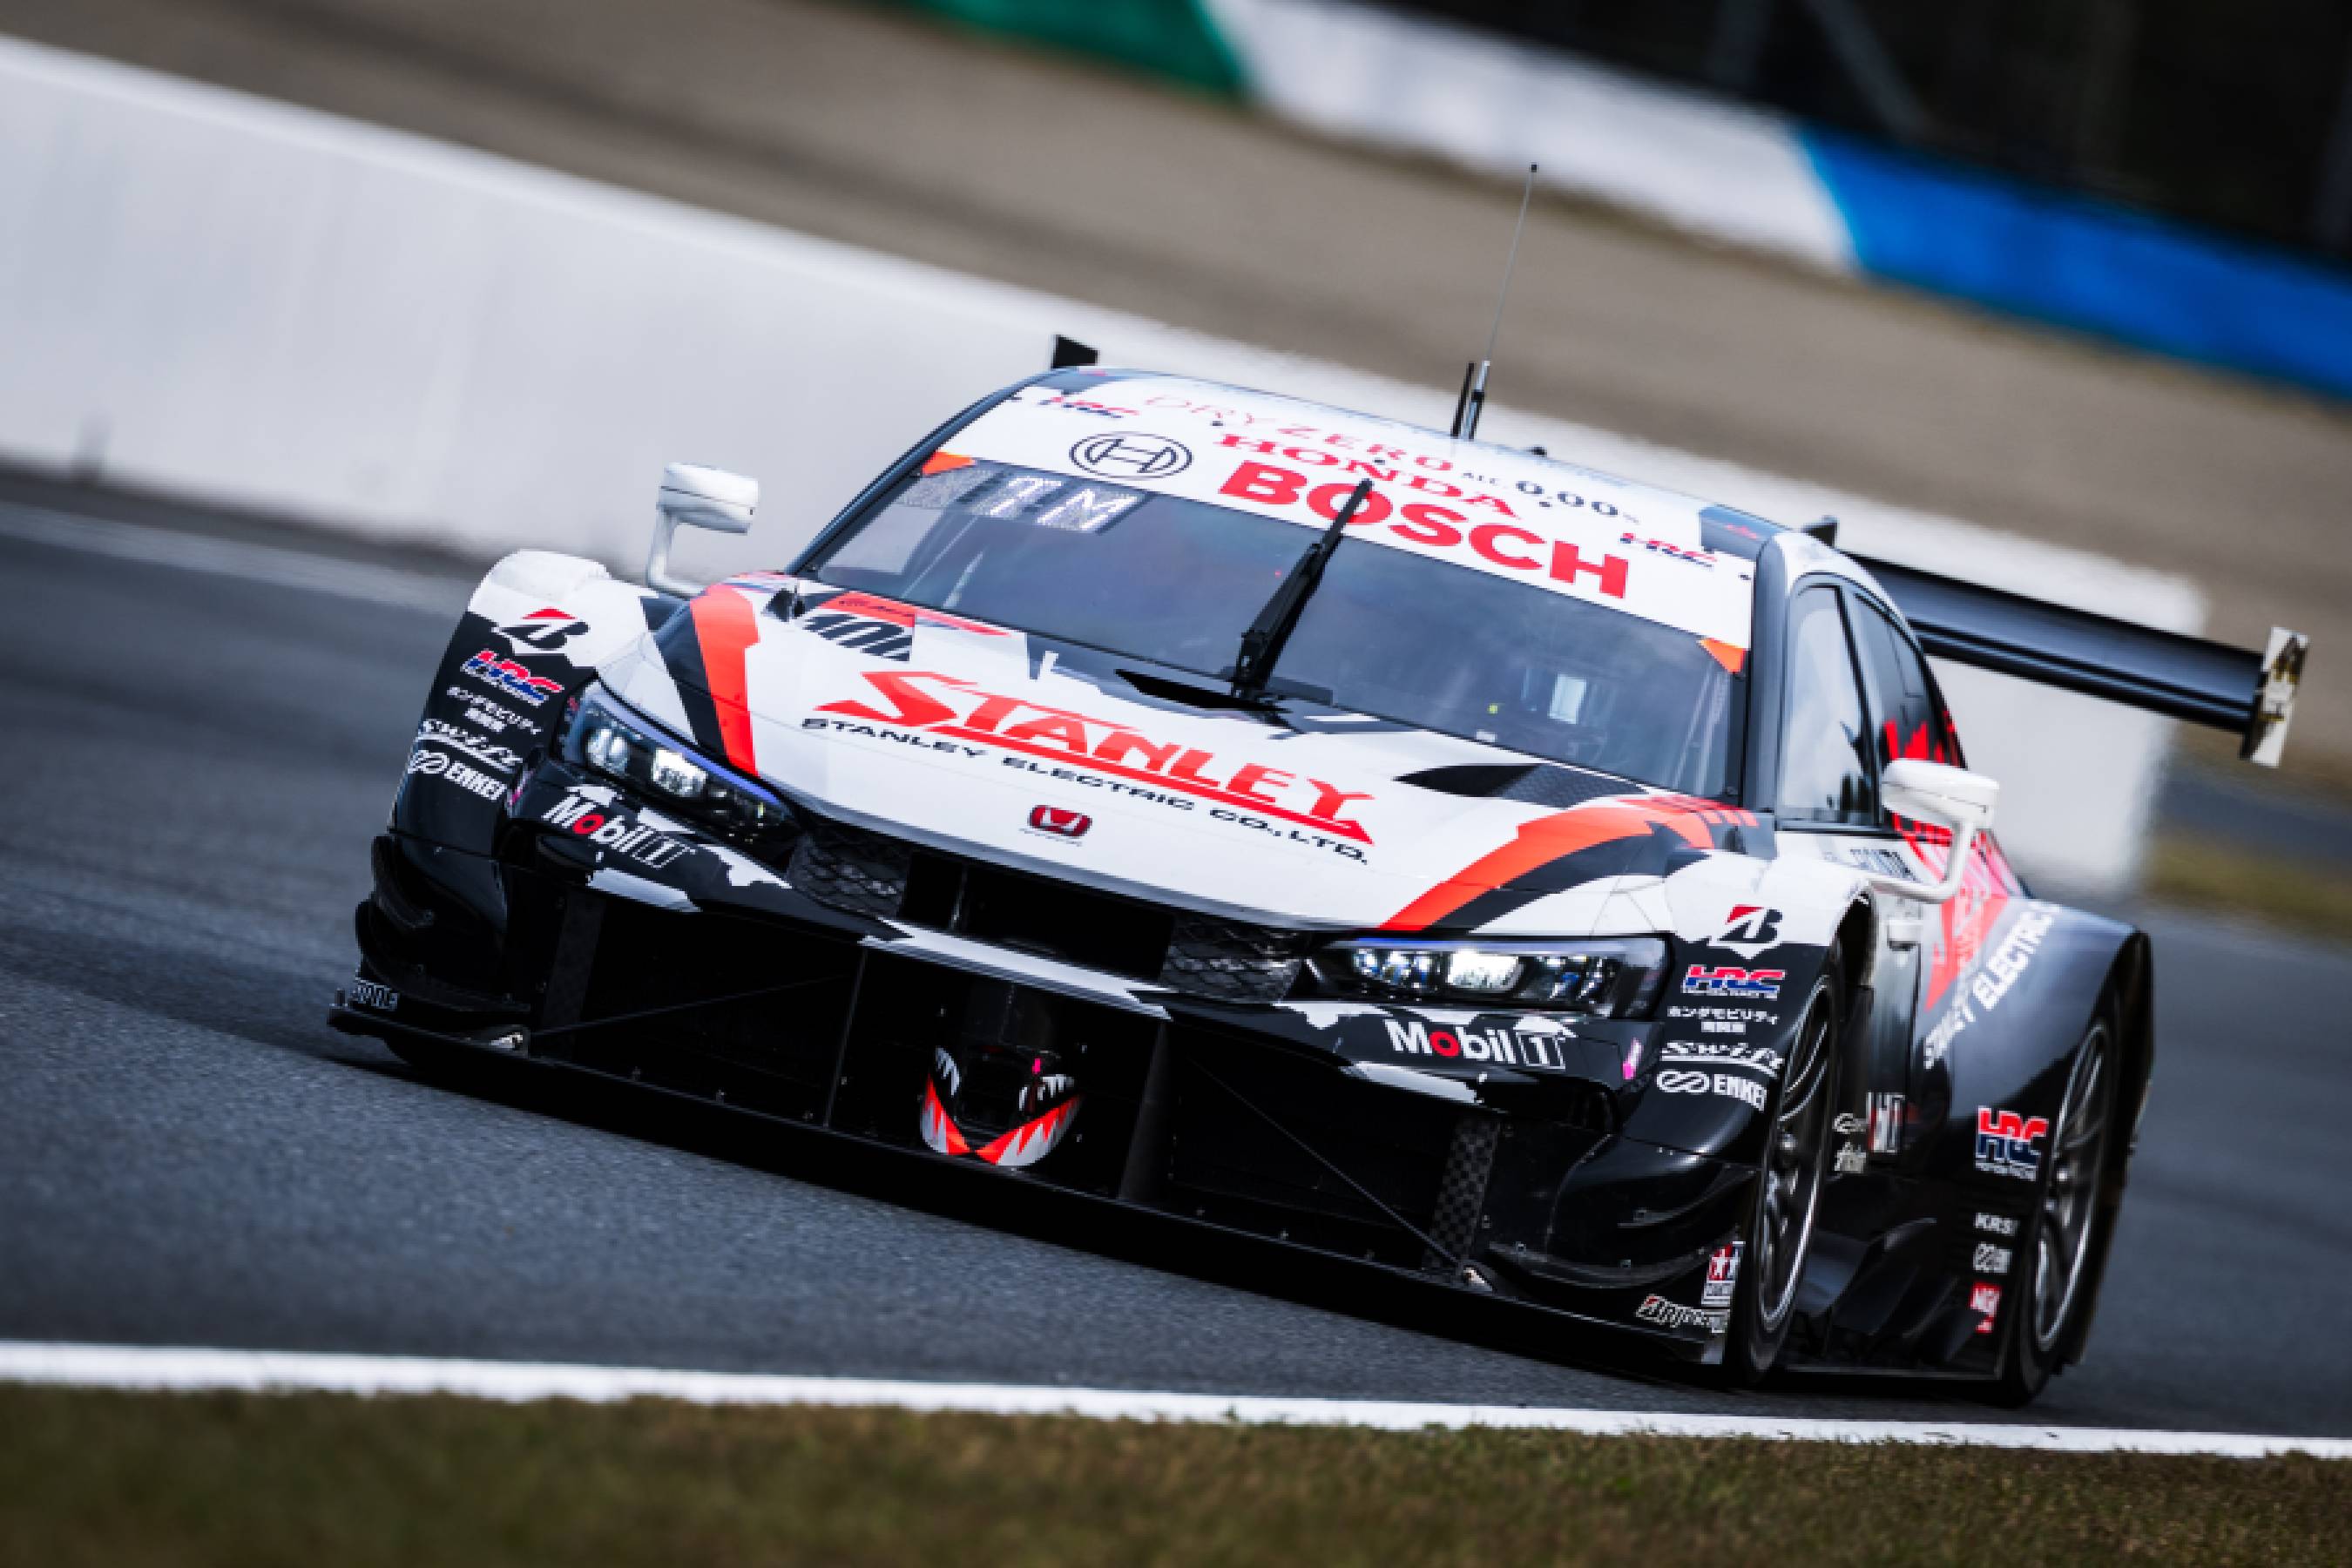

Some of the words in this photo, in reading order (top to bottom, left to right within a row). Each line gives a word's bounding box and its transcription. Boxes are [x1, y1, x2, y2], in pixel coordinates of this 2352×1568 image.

[1213, 432, 1523, 521] HONDA
[1276, 423, 1456, 472] ZERO
[1218, 459, 1628, 599] BOSCH
[460, 648, 564, 704] HRC
[802, 717, 990, 757] STANLEY
[1001, 755, 1193, 811] ELECTRIC
[814, 670, 1376, 821] STANLEY
[540, 794, 657, 854] Mobil
[1682, 963, 1787, 996] HRC
[1383, 1020, 1518, 1066] Mobil
[1975, 1105, 2050, 1166] HRC
